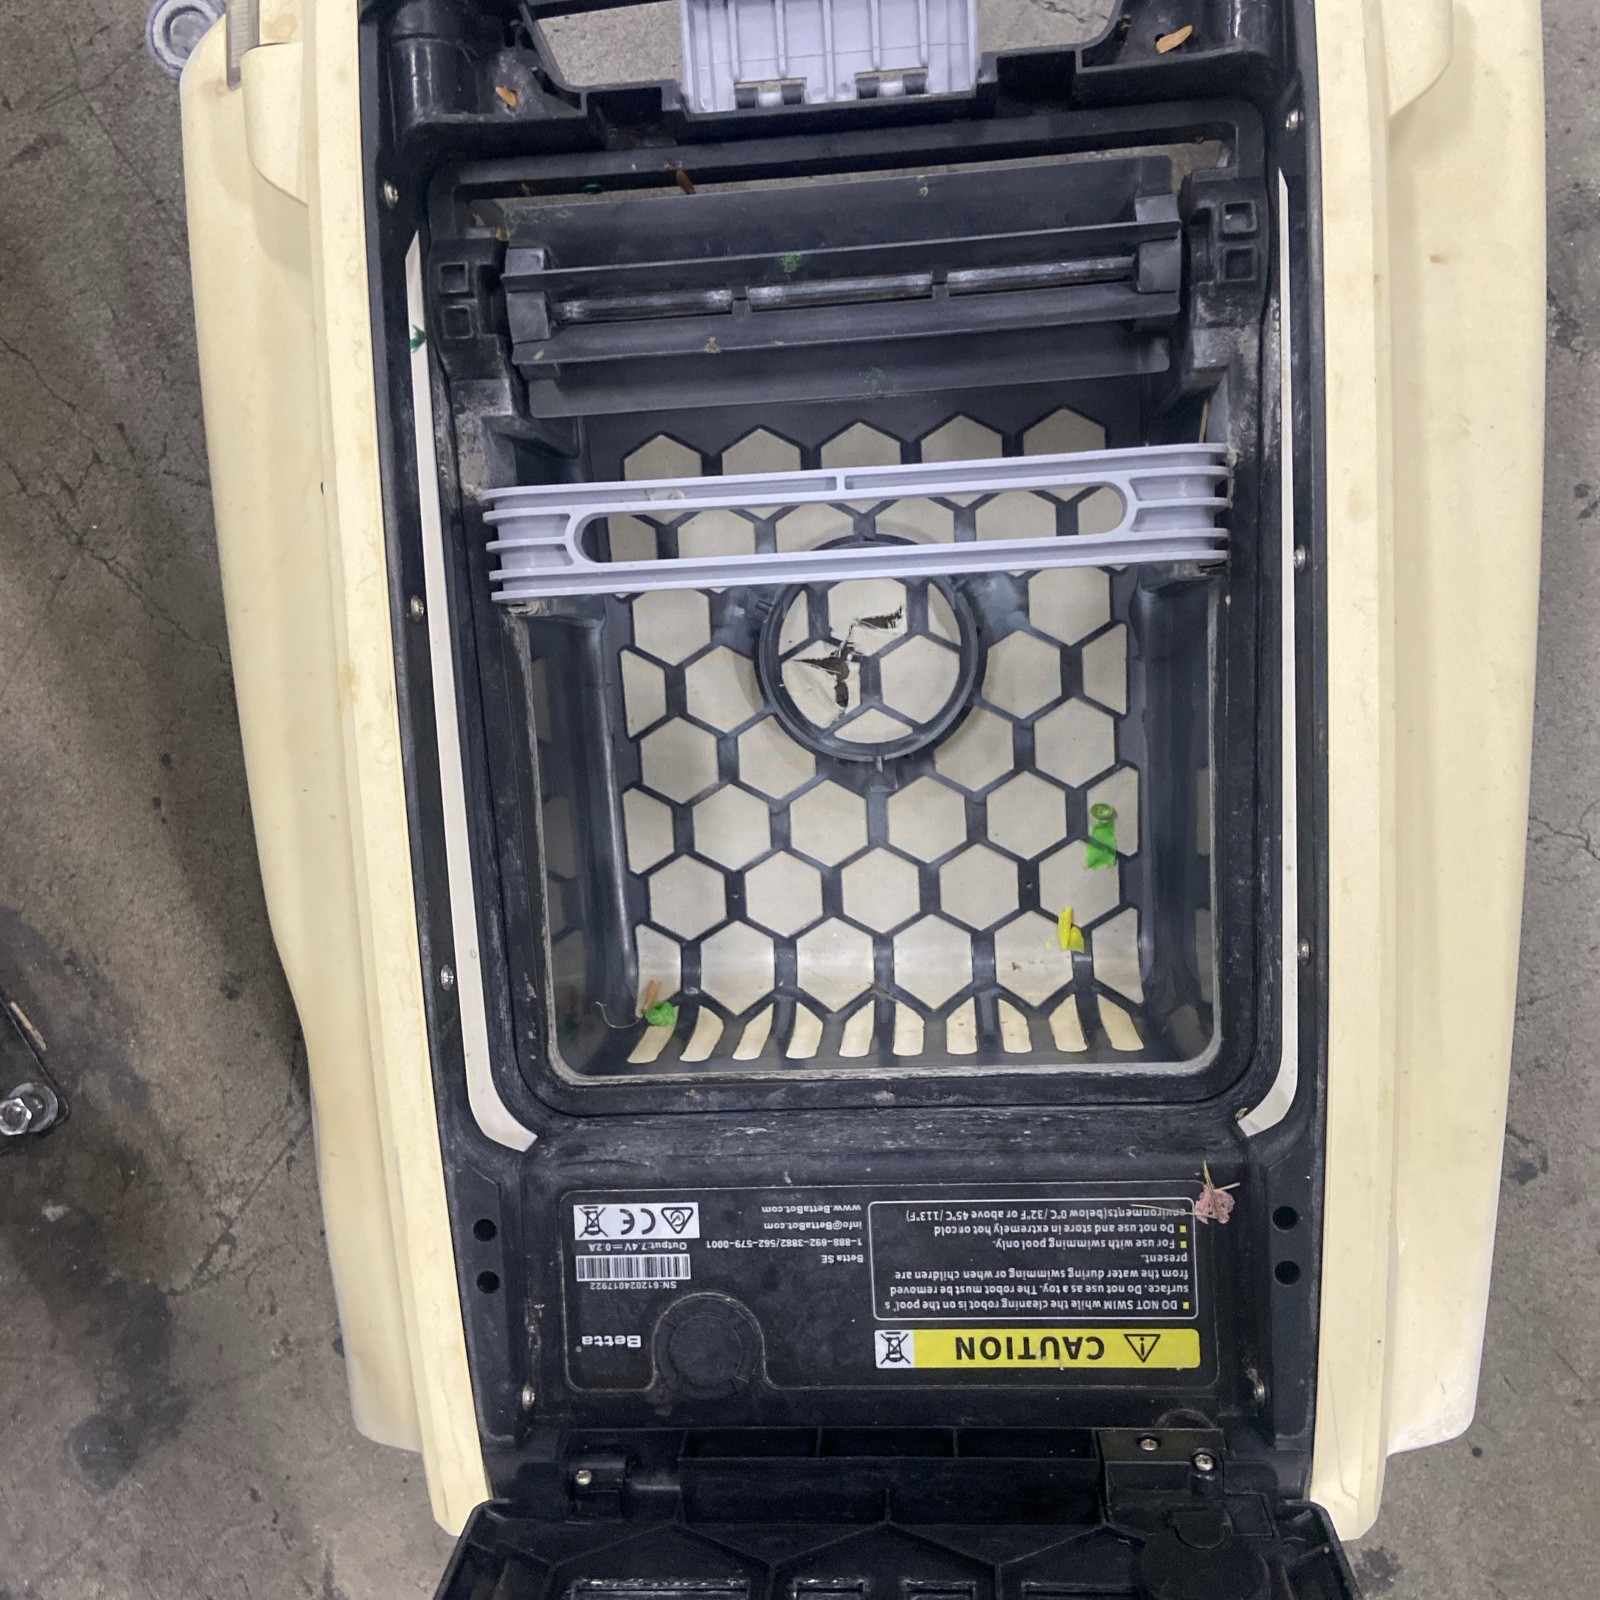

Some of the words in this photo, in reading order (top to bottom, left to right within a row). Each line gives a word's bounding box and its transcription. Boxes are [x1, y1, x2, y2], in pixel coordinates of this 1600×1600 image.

[761, 1205, 861, 1214] www.BettaBot.com
[1006, 1210, 1018, 1219] or
[971, 1211, 1004, 1220] above
[764, 1220, 862, 1230] info@BettaBot.com
[959, 1226, 970, 1234] or
[993, 1223, 1049, 1235] extremely
[1051, 1225, 1061, 1234] in
[1064, 1224, 1092, 1234] store
[1094, 1224, 1115, 1234] and
[1117, 1224, 1136, 1232] use
[1138, 1224, 1157, 1233] not
[1159, 1224, 1175, 1233] Do
[934, 1226, 957, 1237] cold
[972, 1226, 991, 1235] hot
[992, 1239, 1019, 1250] only.
[1022, 1238, 1046, 1250] pool
[1048, 1237, 1106, 1249] swimming
[1107, 1239, 1133, 1249] with
[1135, 1239, 1154, 1247] use
[1156, 1239, 1175, 1249] For
[821, 1254, 835, 1264] SE
[836, 1254, 864, 1263] Betta
[1140, 1252, 1188, 1263] present.
[894, 1271, 912, 1279] are
[914, 1271, 960, 1280] children
[963, 1270, 993, 1280] when
[995, 1270, 1006, 1279] or
[1008, 1267, 1066, 1282] swimming
[1067, 1267, 1105, 1280] during
[1107, 1269, 1138, 1279] water
[1141, 1269, 1159, 1279] the
[1162, 1269, 1189, 1279] from
[590, 1281, 677, 1290] SN:612024017922
[955, 1285, 982, 1295] must
[984, 1285, 1015, 1296] robot
[1017, 1285, 1037, 1295] The
[1039, 1283, 1061, 1295] toy.
[1062, 1285, 1069, 1293] a
[1071, 1285, 1083, 1293] as
[1085, 1285, 1104, 1293] use
[1106, 1285, 1125, 1294] not
[1127, 1285, 1142, 1295] Do
[1144, 1285, 1189, 1295] surface.
[890, 1286, 937, 1296] removed
[940, 1286, 953, 1296] be
[922, 1301, 940, 1311] the
[943, 1301, 956, 1309] on
[958, 1301, 967, 1311] is
[969, 1300, 999, 1311] robot
[1001, 1298, 1049, 1311] cleaning
[1051, 1300, 1069, 1310] the
[1072, 1300, 1101, 1310] while
[1104, 1300, 1134, 1310] SWIM
[1137, 1300, 1159, 1310] NOT
[1162, 1300, 1178, 1310] DO
[581, 1335, 642, 1348] Betta
[955, 1336, 1105, 1360] CAUTION
